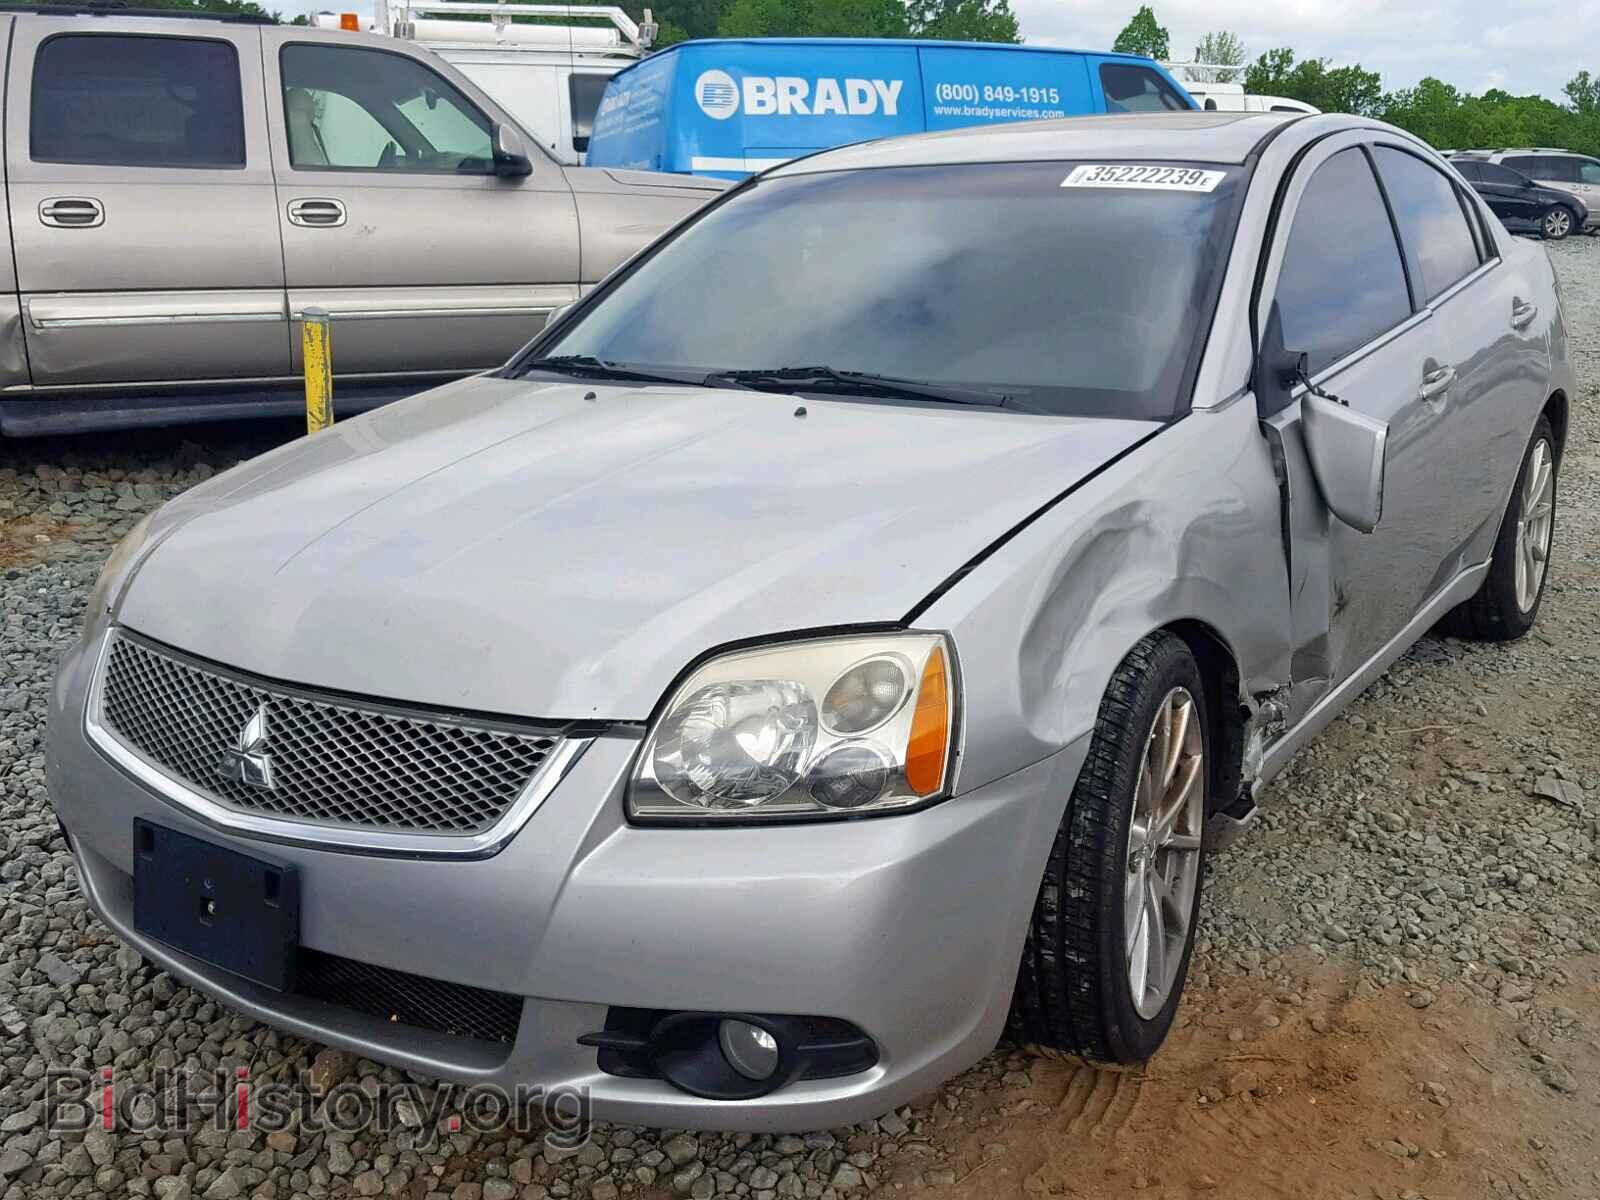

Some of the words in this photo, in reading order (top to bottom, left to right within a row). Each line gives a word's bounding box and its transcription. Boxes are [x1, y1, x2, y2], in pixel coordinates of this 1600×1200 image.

[742, 77, 903, 115] BRADY
[936, 82, 979, 104] (800)
[983, 85, 1060, 104] 849-1915
[934, 105, 1065, 119] www.bradyservices.com
